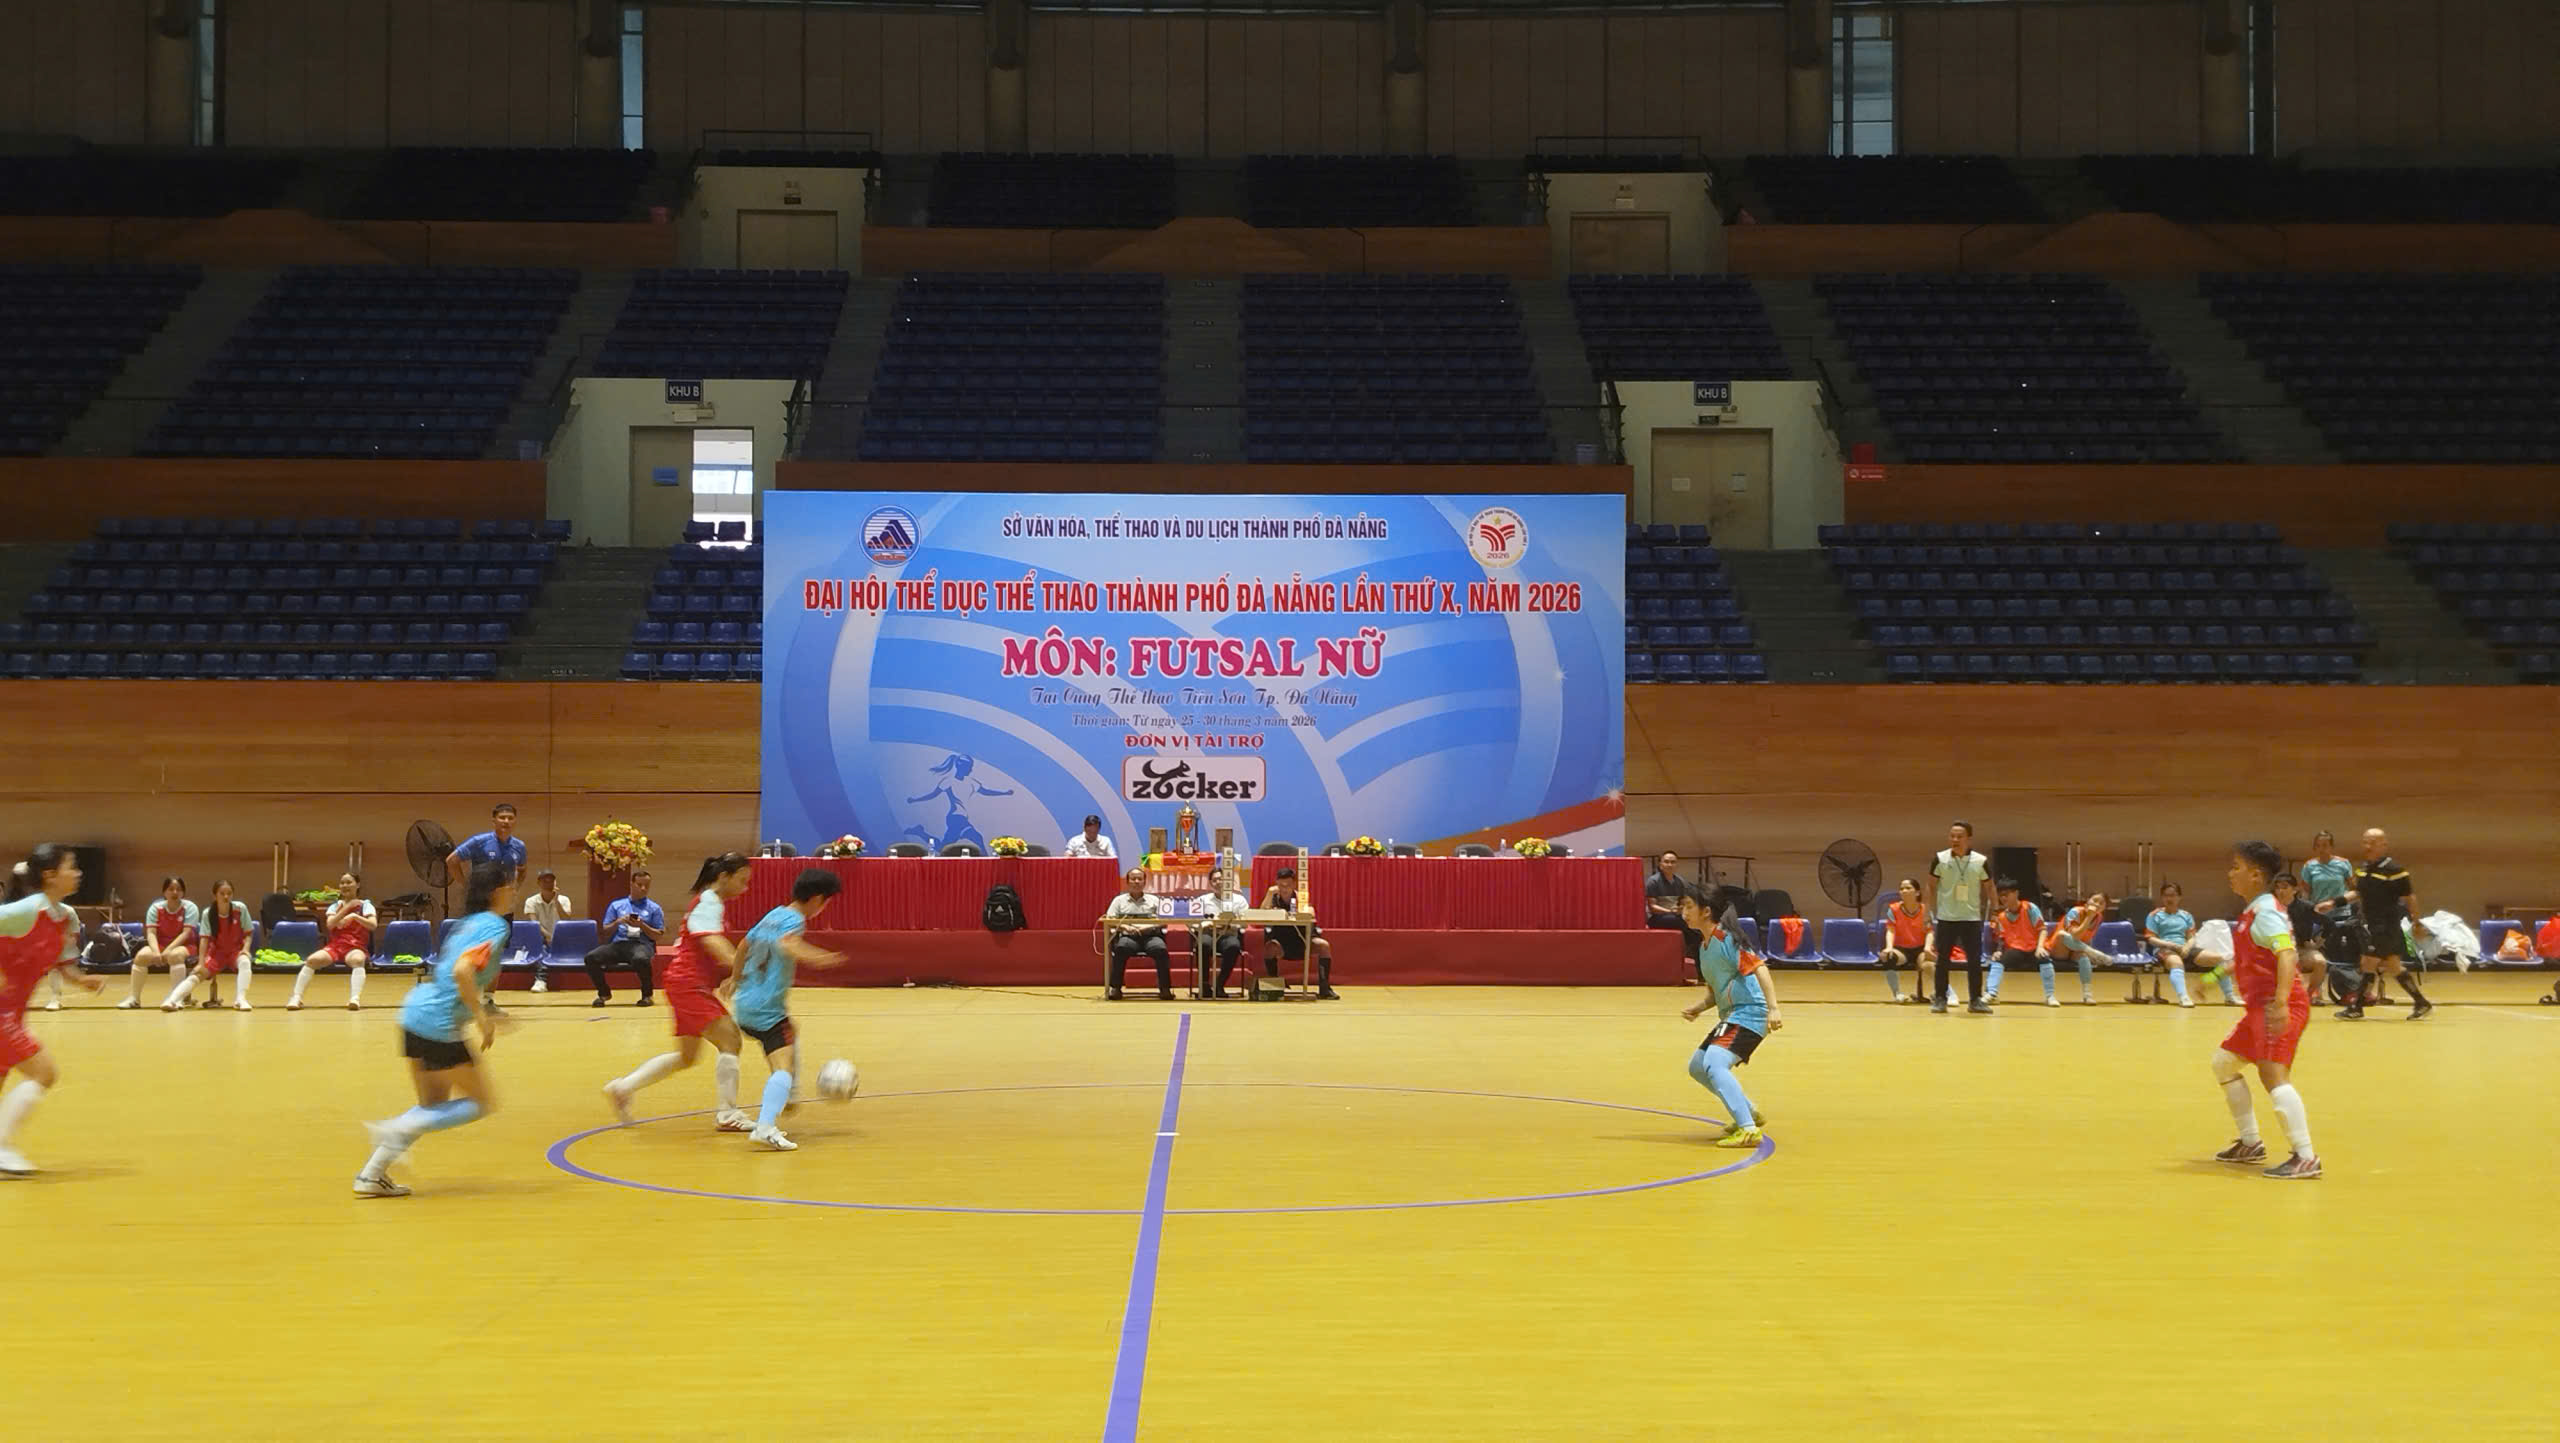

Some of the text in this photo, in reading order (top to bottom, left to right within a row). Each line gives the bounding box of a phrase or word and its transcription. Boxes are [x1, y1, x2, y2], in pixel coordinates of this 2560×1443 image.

[669, 385, 691, 397] KHU
[1697, 387, 1719, 399] KHU
[1003, 512, 1388, 542] SỞ VĂN HÓA, THỂ THAO VÀ DU LỊCH THÀNH PHỐ ĐÀ NẴNG
[805, 569, 1581, 617] ĐẠI HỘI THỂ DỤC THỂ THAO THÀNH PHỐ ĐÀ NẴNG LẦN THỨ X, NĂM 2026
[1003, 627, 1386, 677] MÔN: FUTSAL NỮ
[1141, 688, 1174, 705] thao
[1254, 687, 1280, 708] Tp.
[1180, 714, 1194, 727] 25
[1203, 714, 1217, 727] 30
[1291, 714, 1317, 727] 2026
[1126, 732, 1265, 751] ĐƠN VỊ TÀI TRỢ
[1133, 770, 1257, 799] zocker
[1191, 902, 1202, 914] 2
